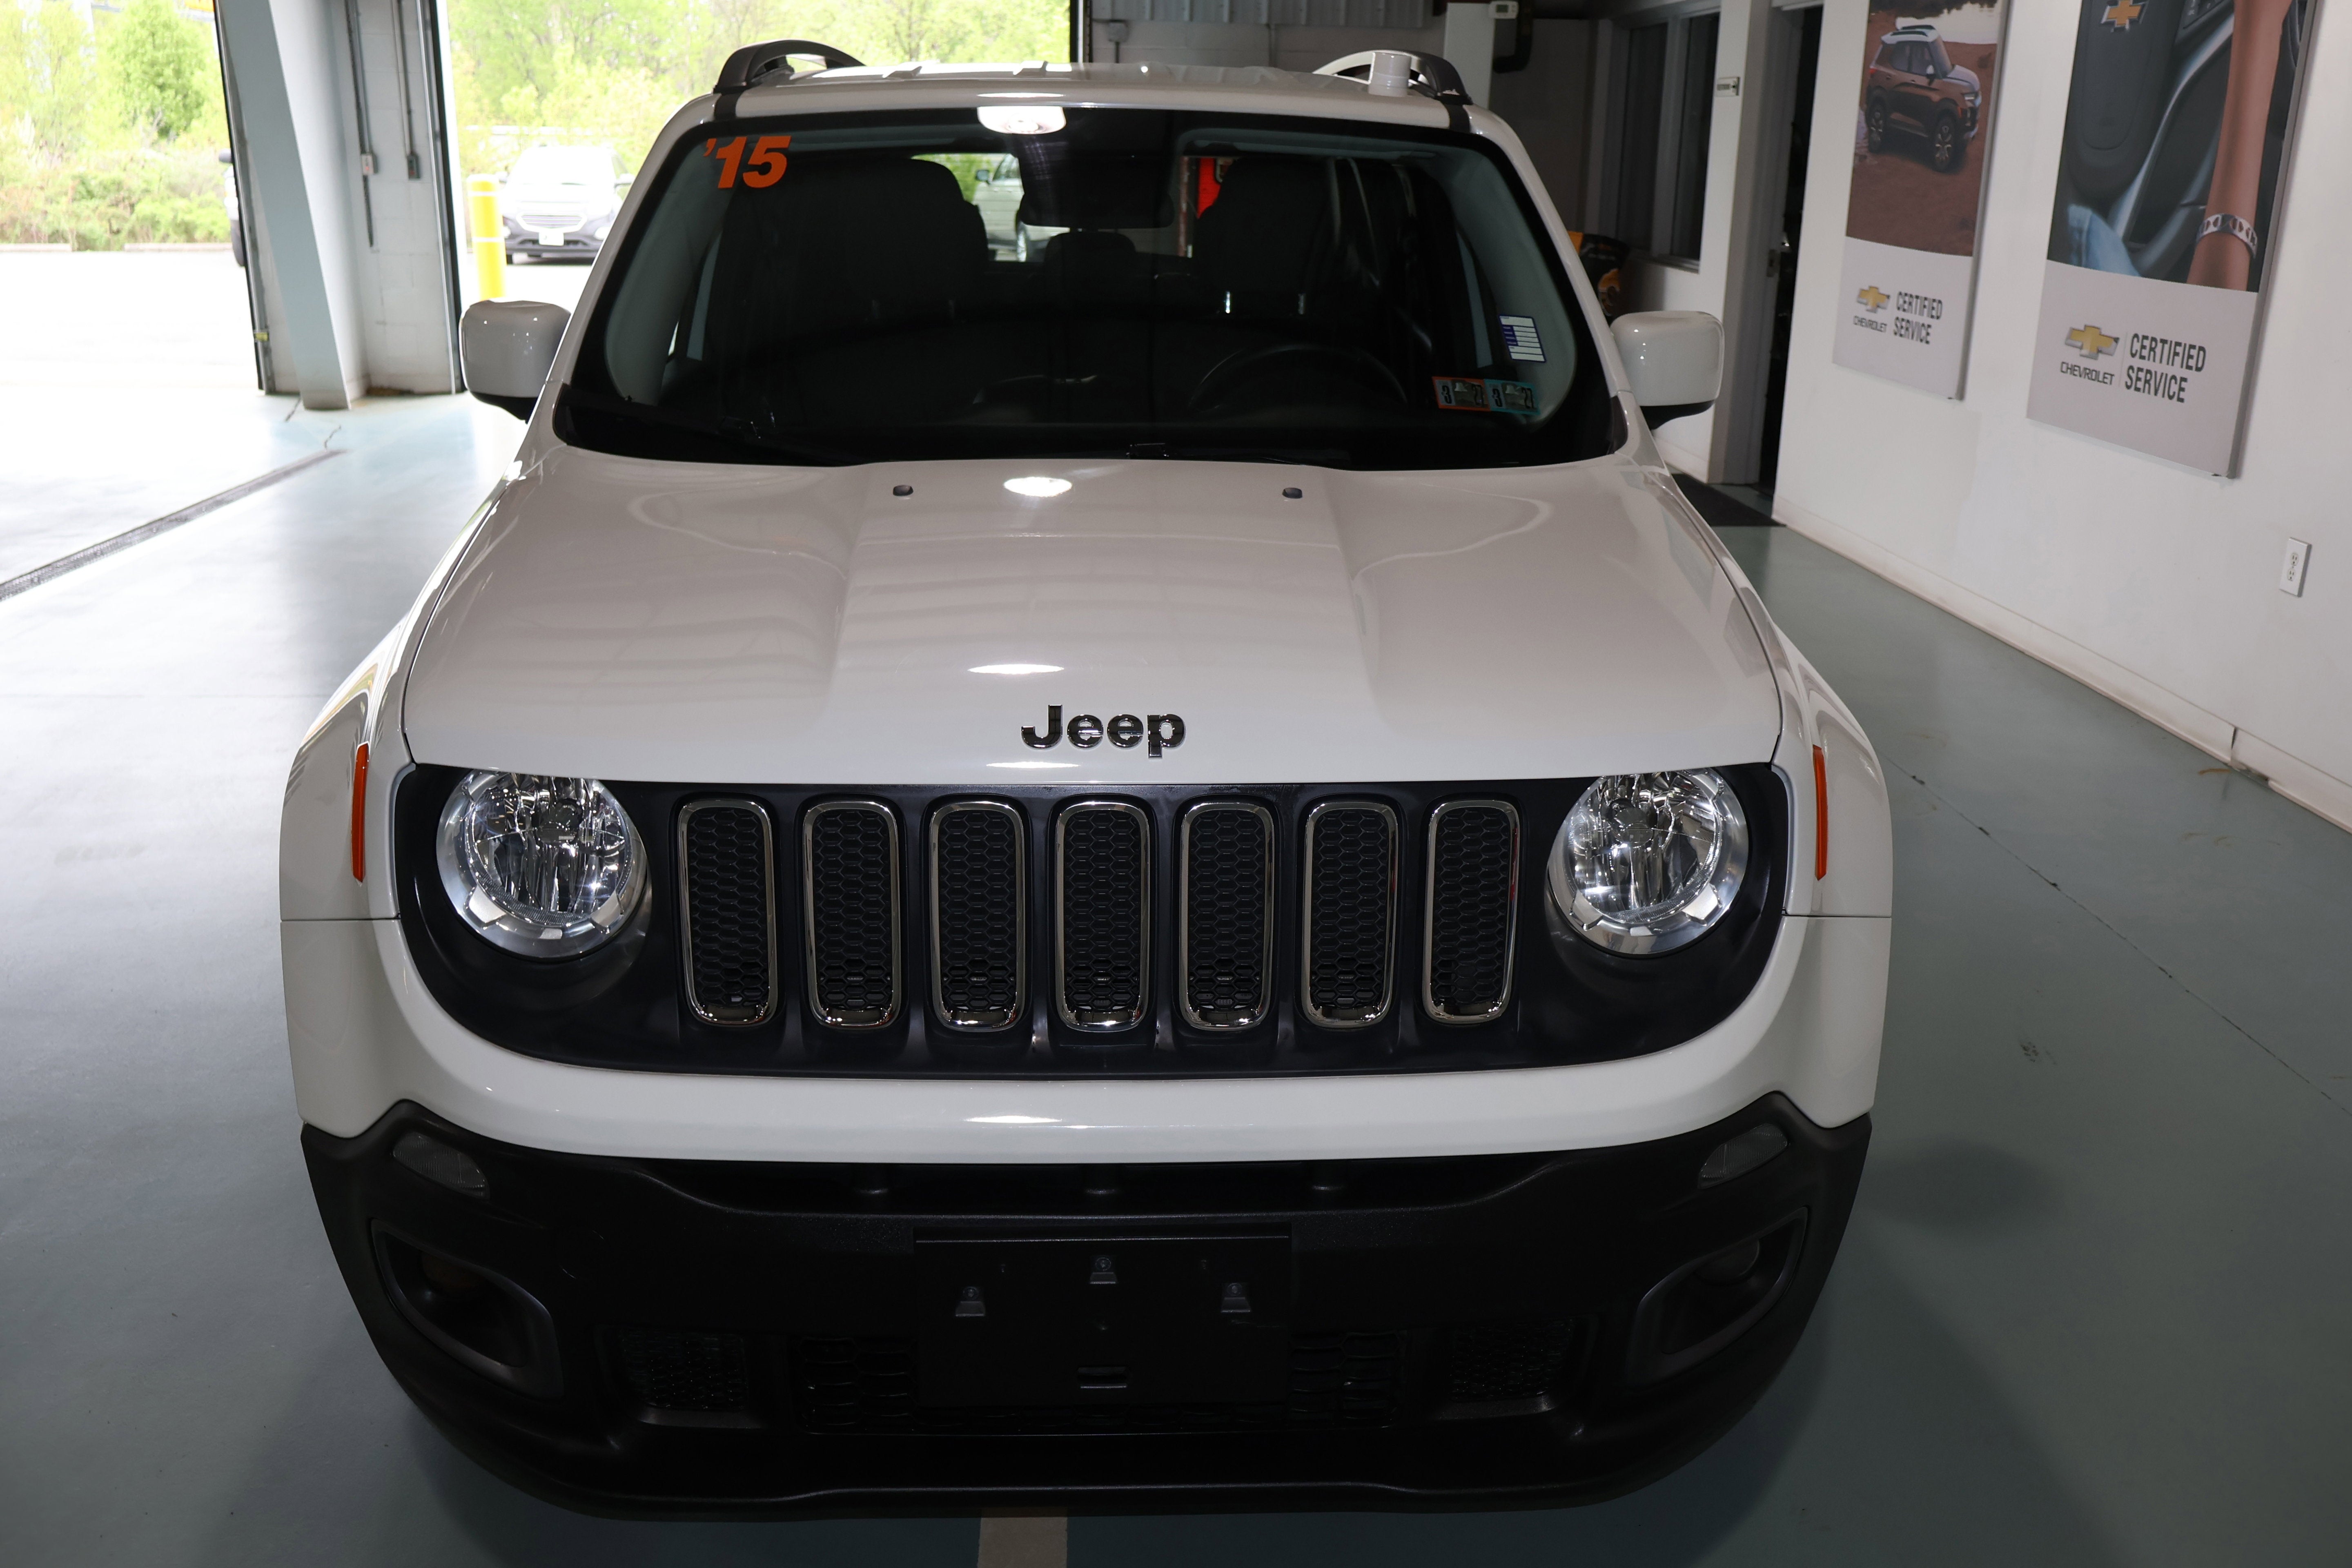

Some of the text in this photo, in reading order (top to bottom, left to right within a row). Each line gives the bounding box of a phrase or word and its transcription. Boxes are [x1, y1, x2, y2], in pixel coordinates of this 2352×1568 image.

[1896, 291, 1943, 320] CERTIFIED
[1893, 316, 1932, 344] SERVICE
[2129, 333, 2206, 372] CERTIFIED
[2060, 361, 2114, 385] CHEVROLET
[2125, 365, 2188, 403] SERVICE
[1021, 705, 1186, 759] Jeep
